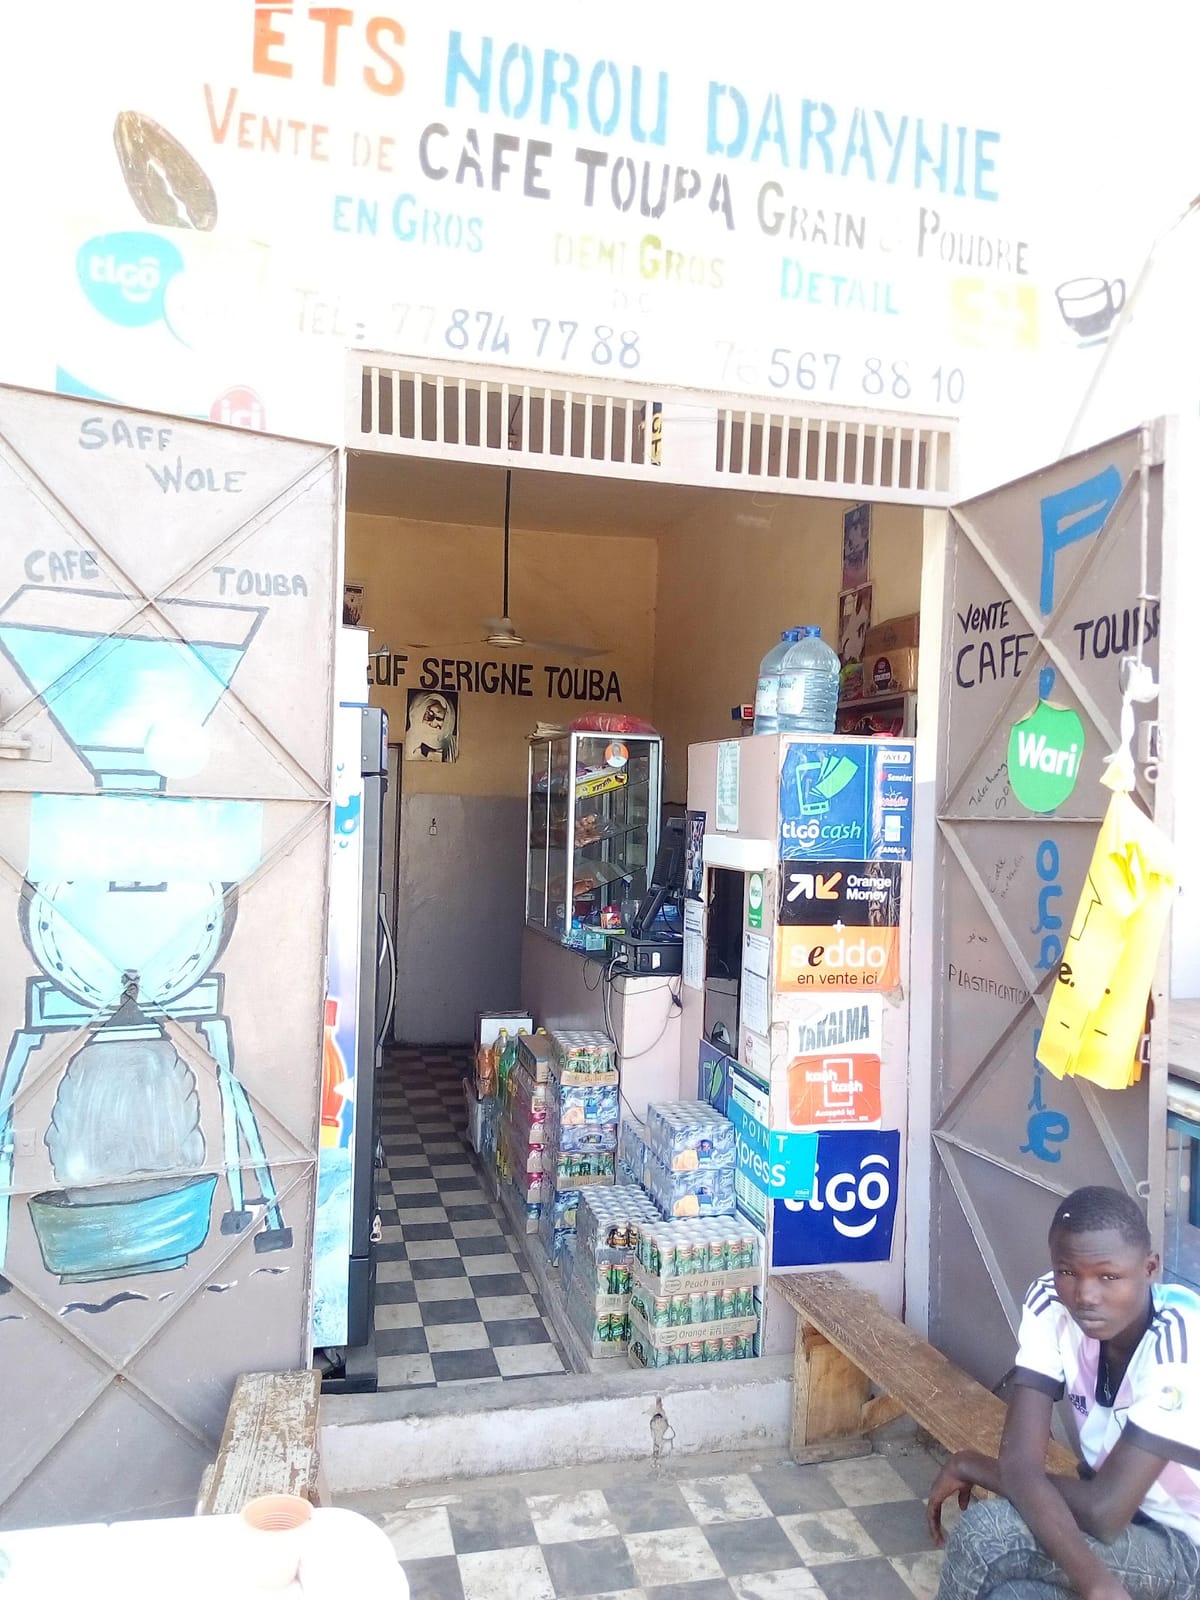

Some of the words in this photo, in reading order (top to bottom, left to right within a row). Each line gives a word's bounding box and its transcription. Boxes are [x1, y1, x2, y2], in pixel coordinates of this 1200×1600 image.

[444, 30, 668, 146] NOROU
[706, 80, 1001, 202] DARAYNIE
[203, 83, 330, 163] VENTE
[419, 121, 552, 200] CAFE
[757, 181, 867, 250] GRAIN
[917, 206, 1029, 276] POUDRE
[332, 194, 378, 236] EN
[391, 192, 484, 253] GROS
[780, 256, 899, 316] DETAIL
[532, 317, 578, 361] 77
[592, 325, 641, 369] 88
[767, 348, 841, 391] 567
[861, 357, 911, 400] 88
[931, 367, 965, 405] 10
[145, 455, 248, 494] WOLE
[24, 550, 100, 582] CAFE
[212, 566, 308, 598] TOUBA
[420, 656, 534, 697] SERIGNE
[544, 665, 622, 702] TOUBA
[956, 633, 1035, 688] CAFE
[1017, 730, 1077, 778] Wari
[821, 820, 862, 839] cash
[846, 875, 892, 890] Orange
[846, 888, 887, 903] Money
[790, 937, 886, 968] seddo
[797, 974, 814, 985] en
[819, 971, 858, 985] vente
[862, 970, 878, 985] ici
